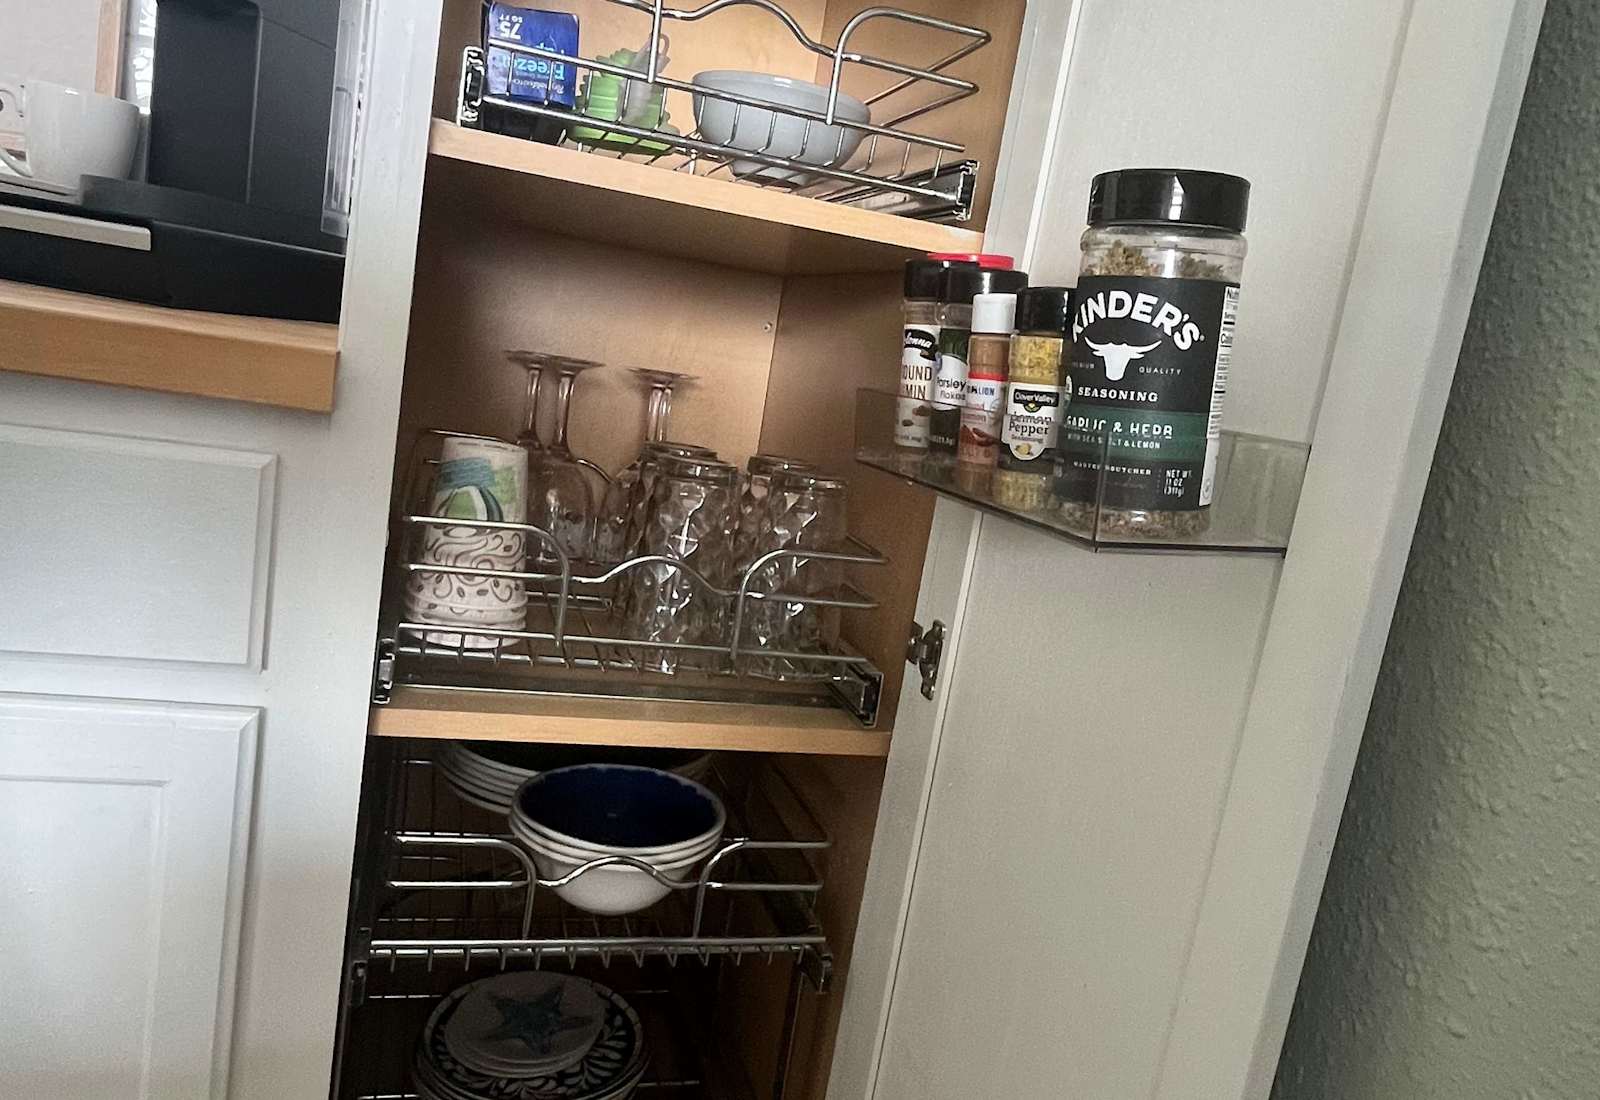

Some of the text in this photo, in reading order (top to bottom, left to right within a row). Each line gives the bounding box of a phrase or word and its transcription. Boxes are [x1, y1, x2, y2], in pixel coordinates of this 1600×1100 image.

[499, 21, 521, 40] 75
[1072, 290, 1201, 350] KINDER'S
[1138, 366, 1182, 376] QUALITY
[1078, 386, 1159, 402] SEASONING
[1008, 421, 1050, 436] Pepper
[1113, 421, 1123, 433] &
[1131, 440, 1161, 449] LEMON
[1166, 469, 1180, 478] NET
